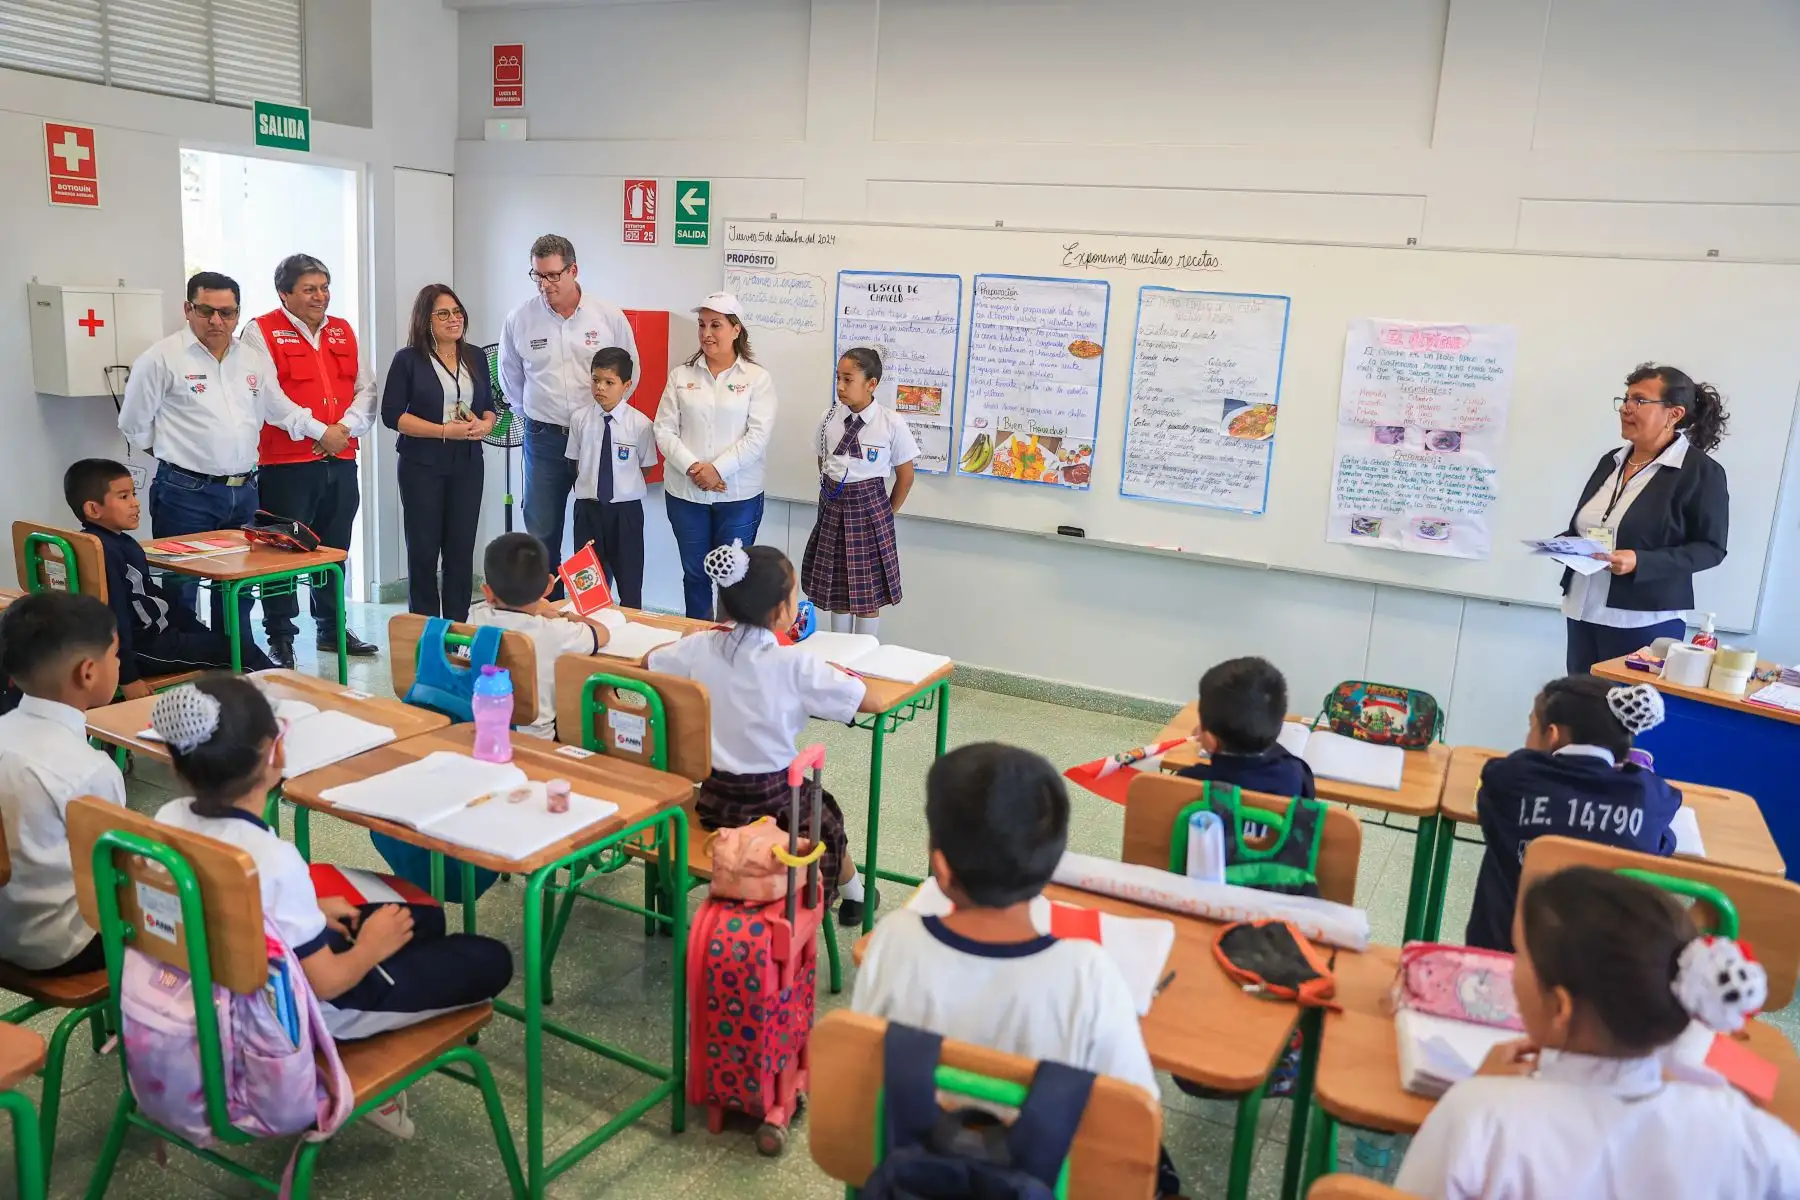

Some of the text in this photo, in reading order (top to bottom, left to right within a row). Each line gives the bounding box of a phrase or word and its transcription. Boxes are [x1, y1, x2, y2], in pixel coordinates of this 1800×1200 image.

[259, 113, 306, 141] SALIDA
[57, 183, 91, 192] BOTIQUÍN
[643, 231, 654, 241] 25
[677, 230, 706, 239] SALIDA
[728, 226, 756, 243] Jueves
[758, 232, 766, 242] 5
[766, 232, 773, 242] de
[805, 232, 815, 244] del
[817, 234, 836, 246] 2024
[726, 252, 775, 265] PROPÓSITO
[1063, 242, 1127, 270] Exponemos
[1131, 248, 1173, 267] nuestras
[868, 283, 919, 294] EL SECO DE
[979, 283, 1019, 296] Preparación
[870, 293, 904, 303] CHAVELO
[625, 737, 641, 747] ANIN
[1518, 796, 1644, 837] I.E. 14790
